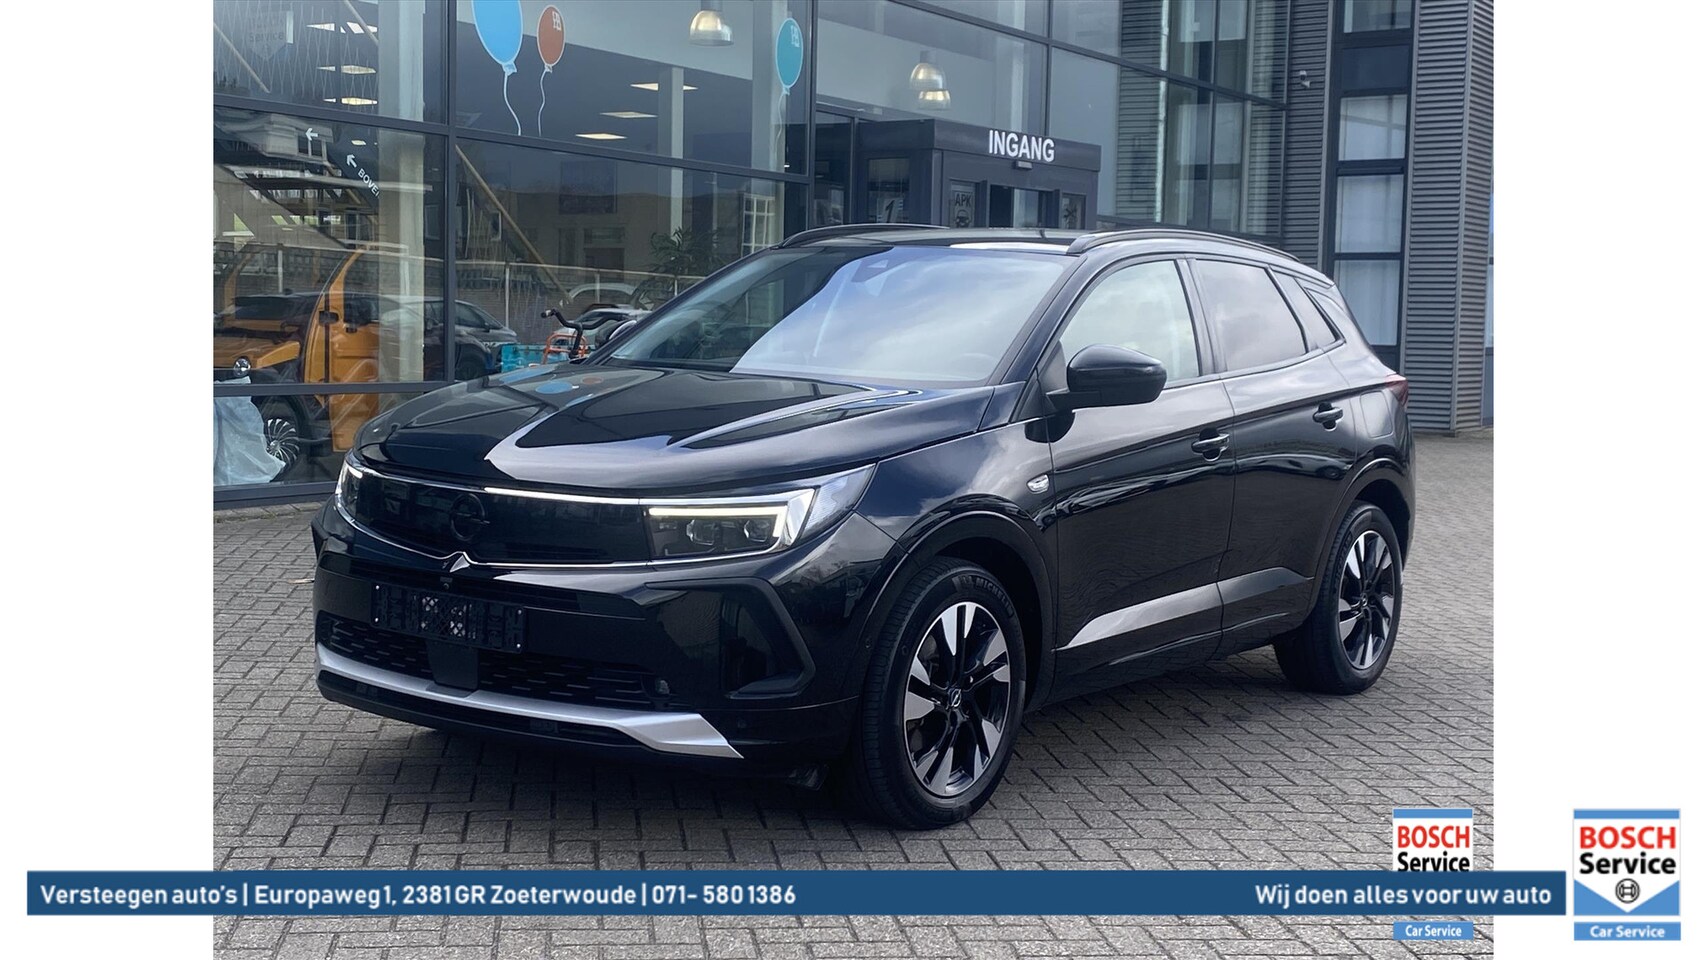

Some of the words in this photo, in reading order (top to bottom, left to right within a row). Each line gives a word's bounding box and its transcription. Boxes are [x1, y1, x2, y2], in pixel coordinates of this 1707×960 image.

[988, 129, 1055, 162] INGANG
[954, 192, 972, 207] APK
[975, 577, 1016, 618] MICHELIN
